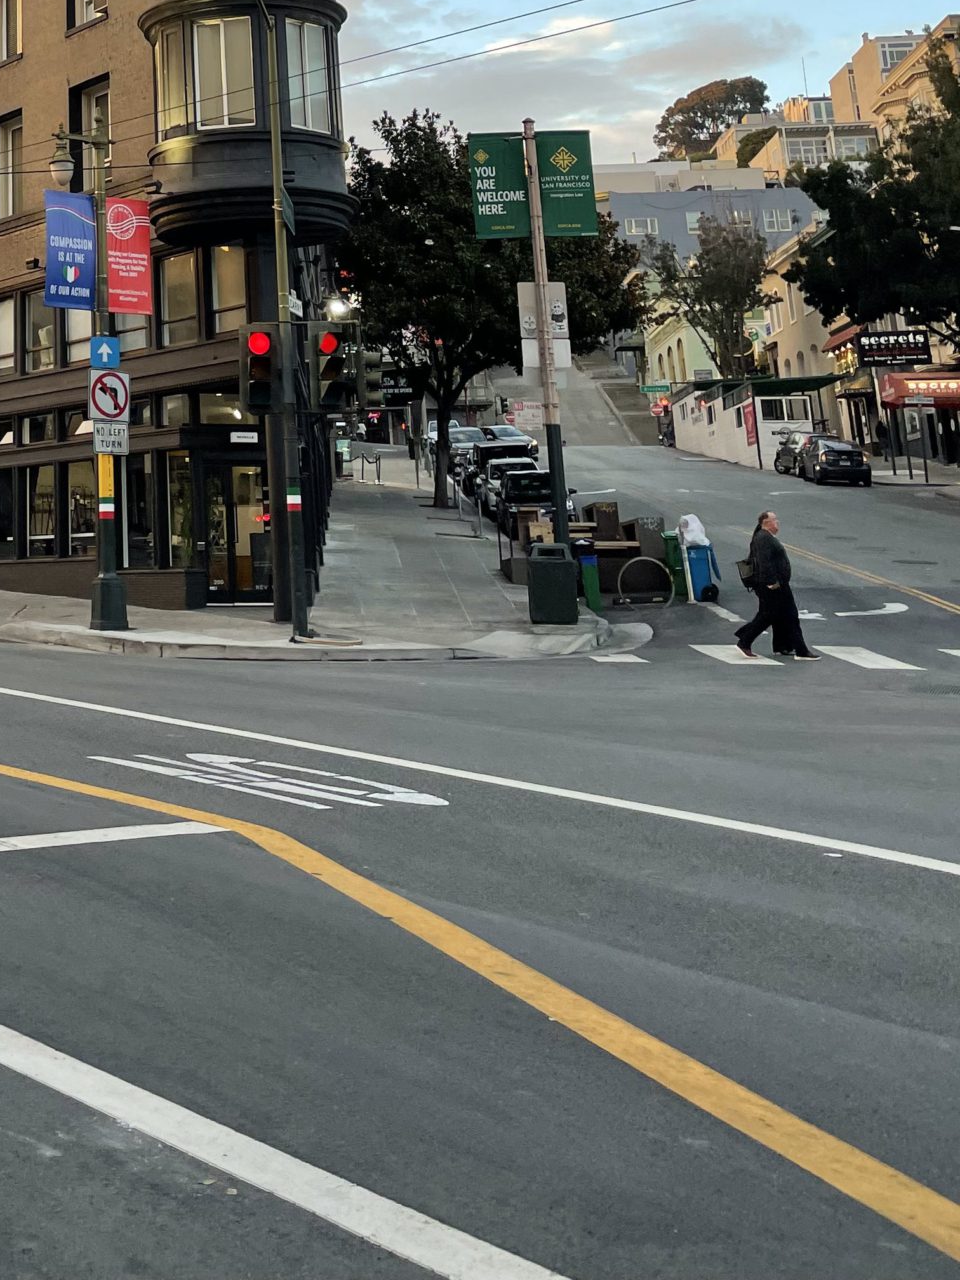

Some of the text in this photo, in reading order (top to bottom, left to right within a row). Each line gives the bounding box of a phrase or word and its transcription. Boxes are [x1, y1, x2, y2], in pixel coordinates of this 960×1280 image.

[474, 166, 496, 178] YOU
[476, 179, 496, 190] ARE
[476, 190, 527, 203] WELCOME
[478, 204, 507, 215] HERE.
[50, 235, 93, 251] COMPASSION
[58, 251, 85, 264] IS AT THE
[50, 284, 90, 298] OF OUR ACTION
[860, 332, 925, 345] secrets
[96, 426, 126, 437] NO LEFT
[100, 439, 122, 449] TURN
